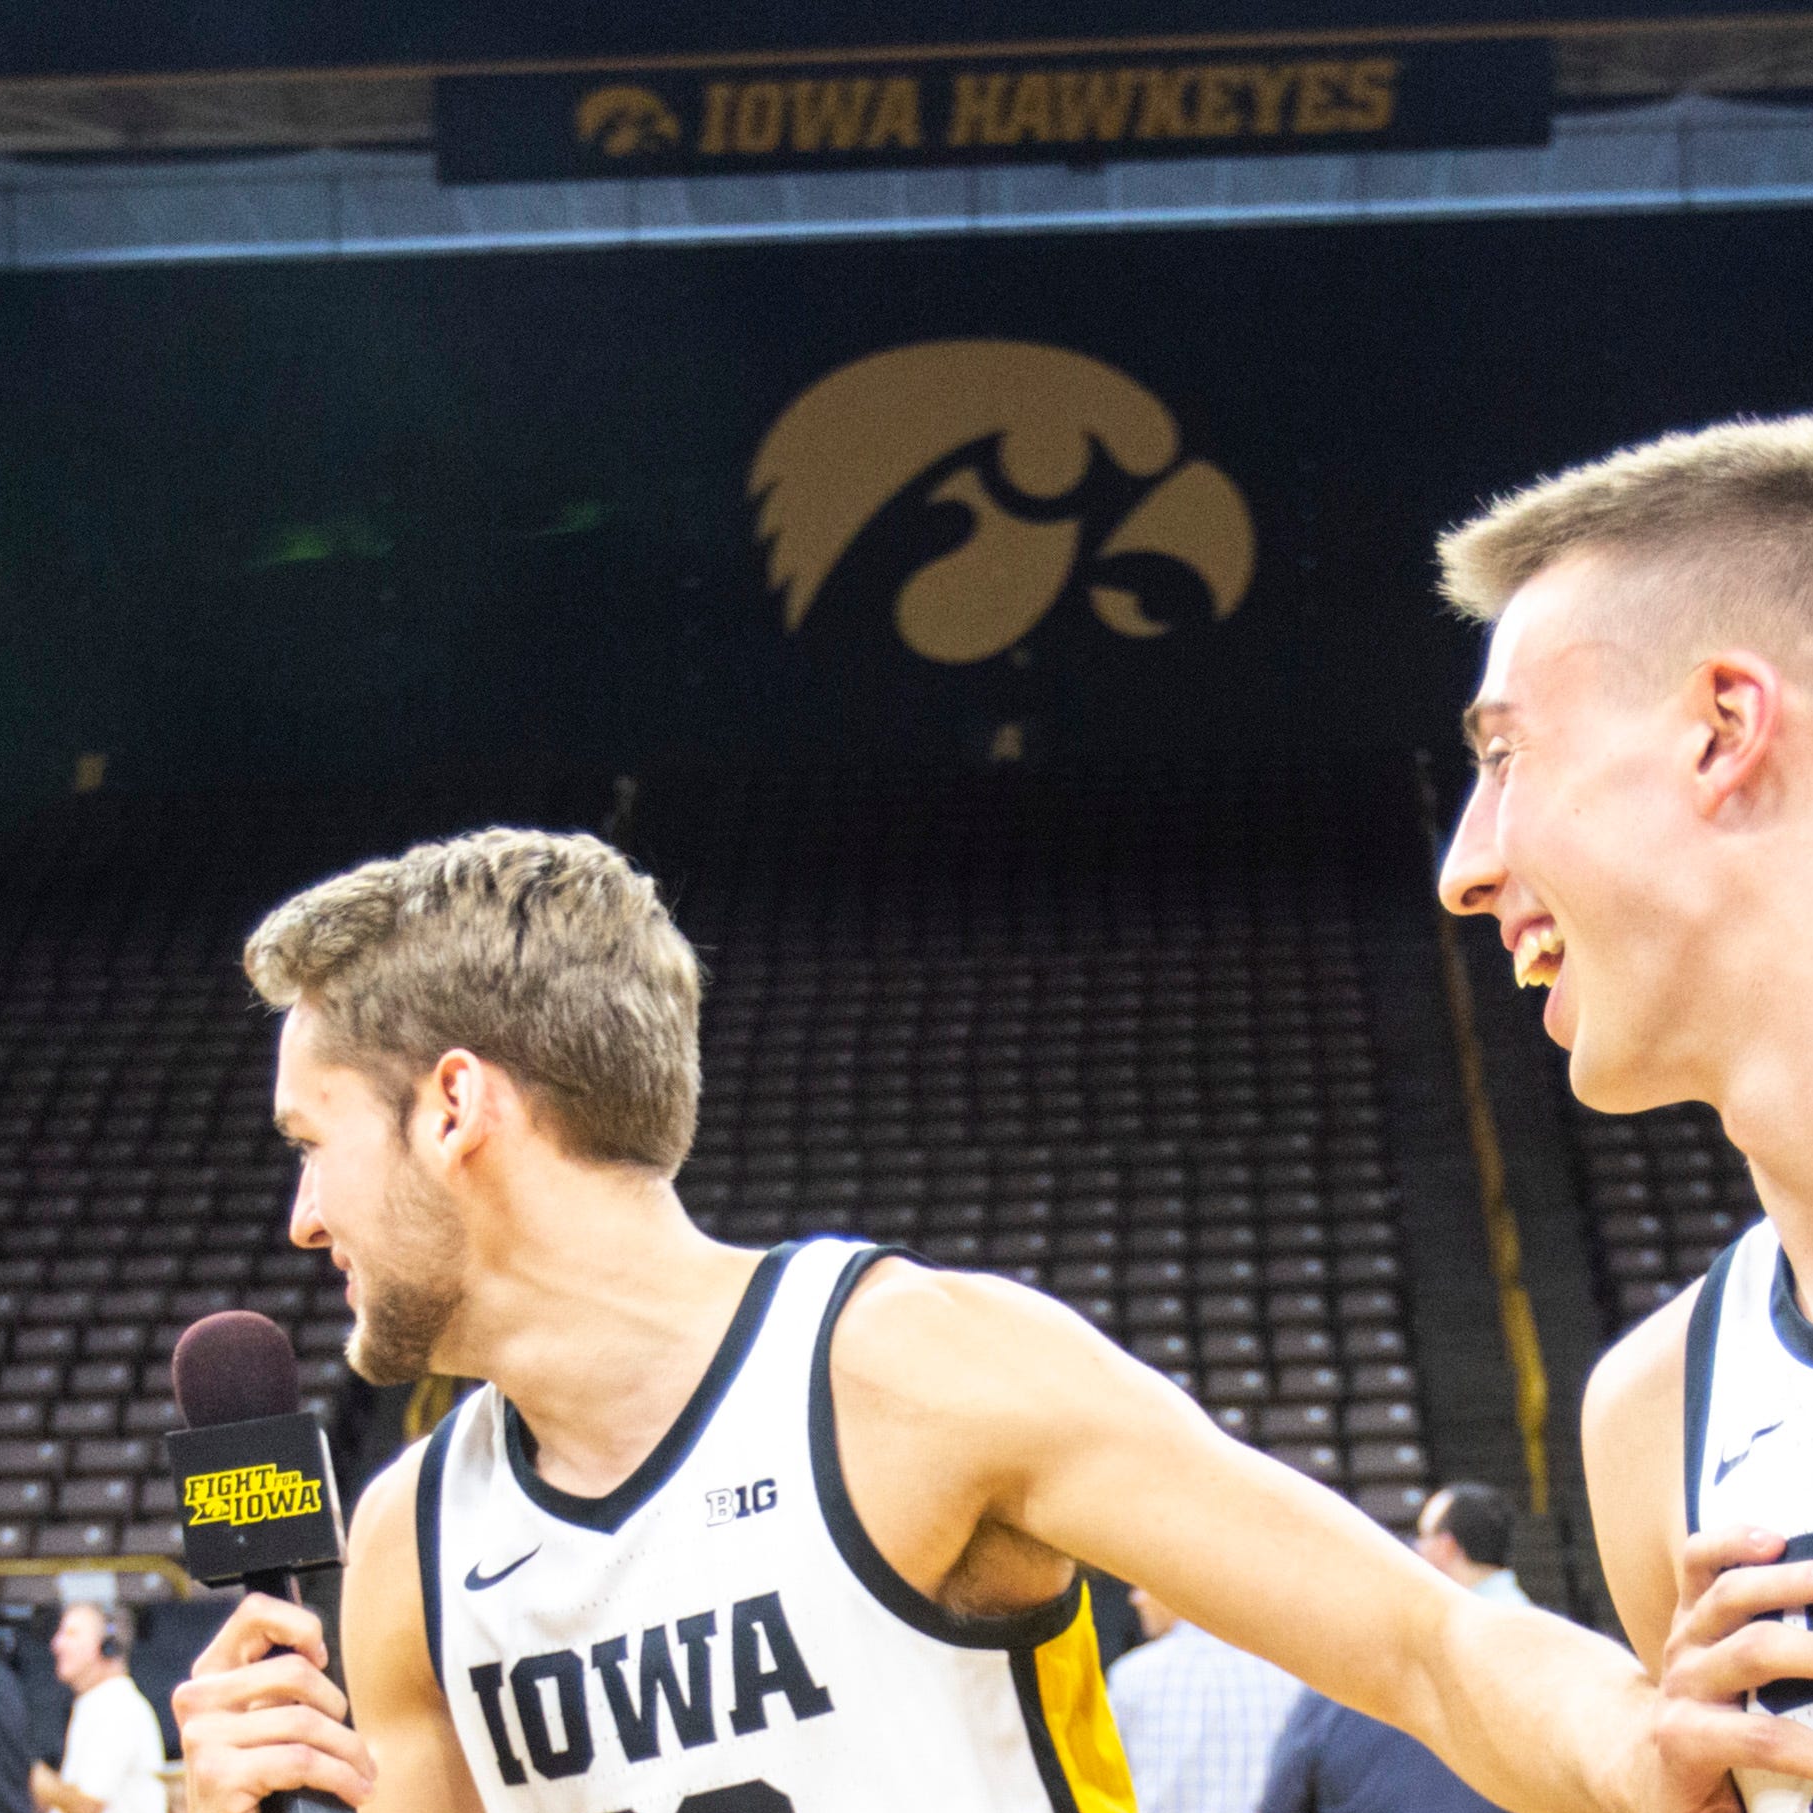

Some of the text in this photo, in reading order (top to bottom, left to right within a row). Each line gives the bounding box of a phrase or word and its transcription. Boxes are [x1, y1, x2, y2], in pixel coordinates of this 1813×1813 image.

[697, 59, 1399, 156] IOWA HAWKEYES
[188, 1467, 300, 1501] FIGHT FOR
[234, 1485, 318, 1521] IOWA
[468, 1590, 835, 1787] IOWA
